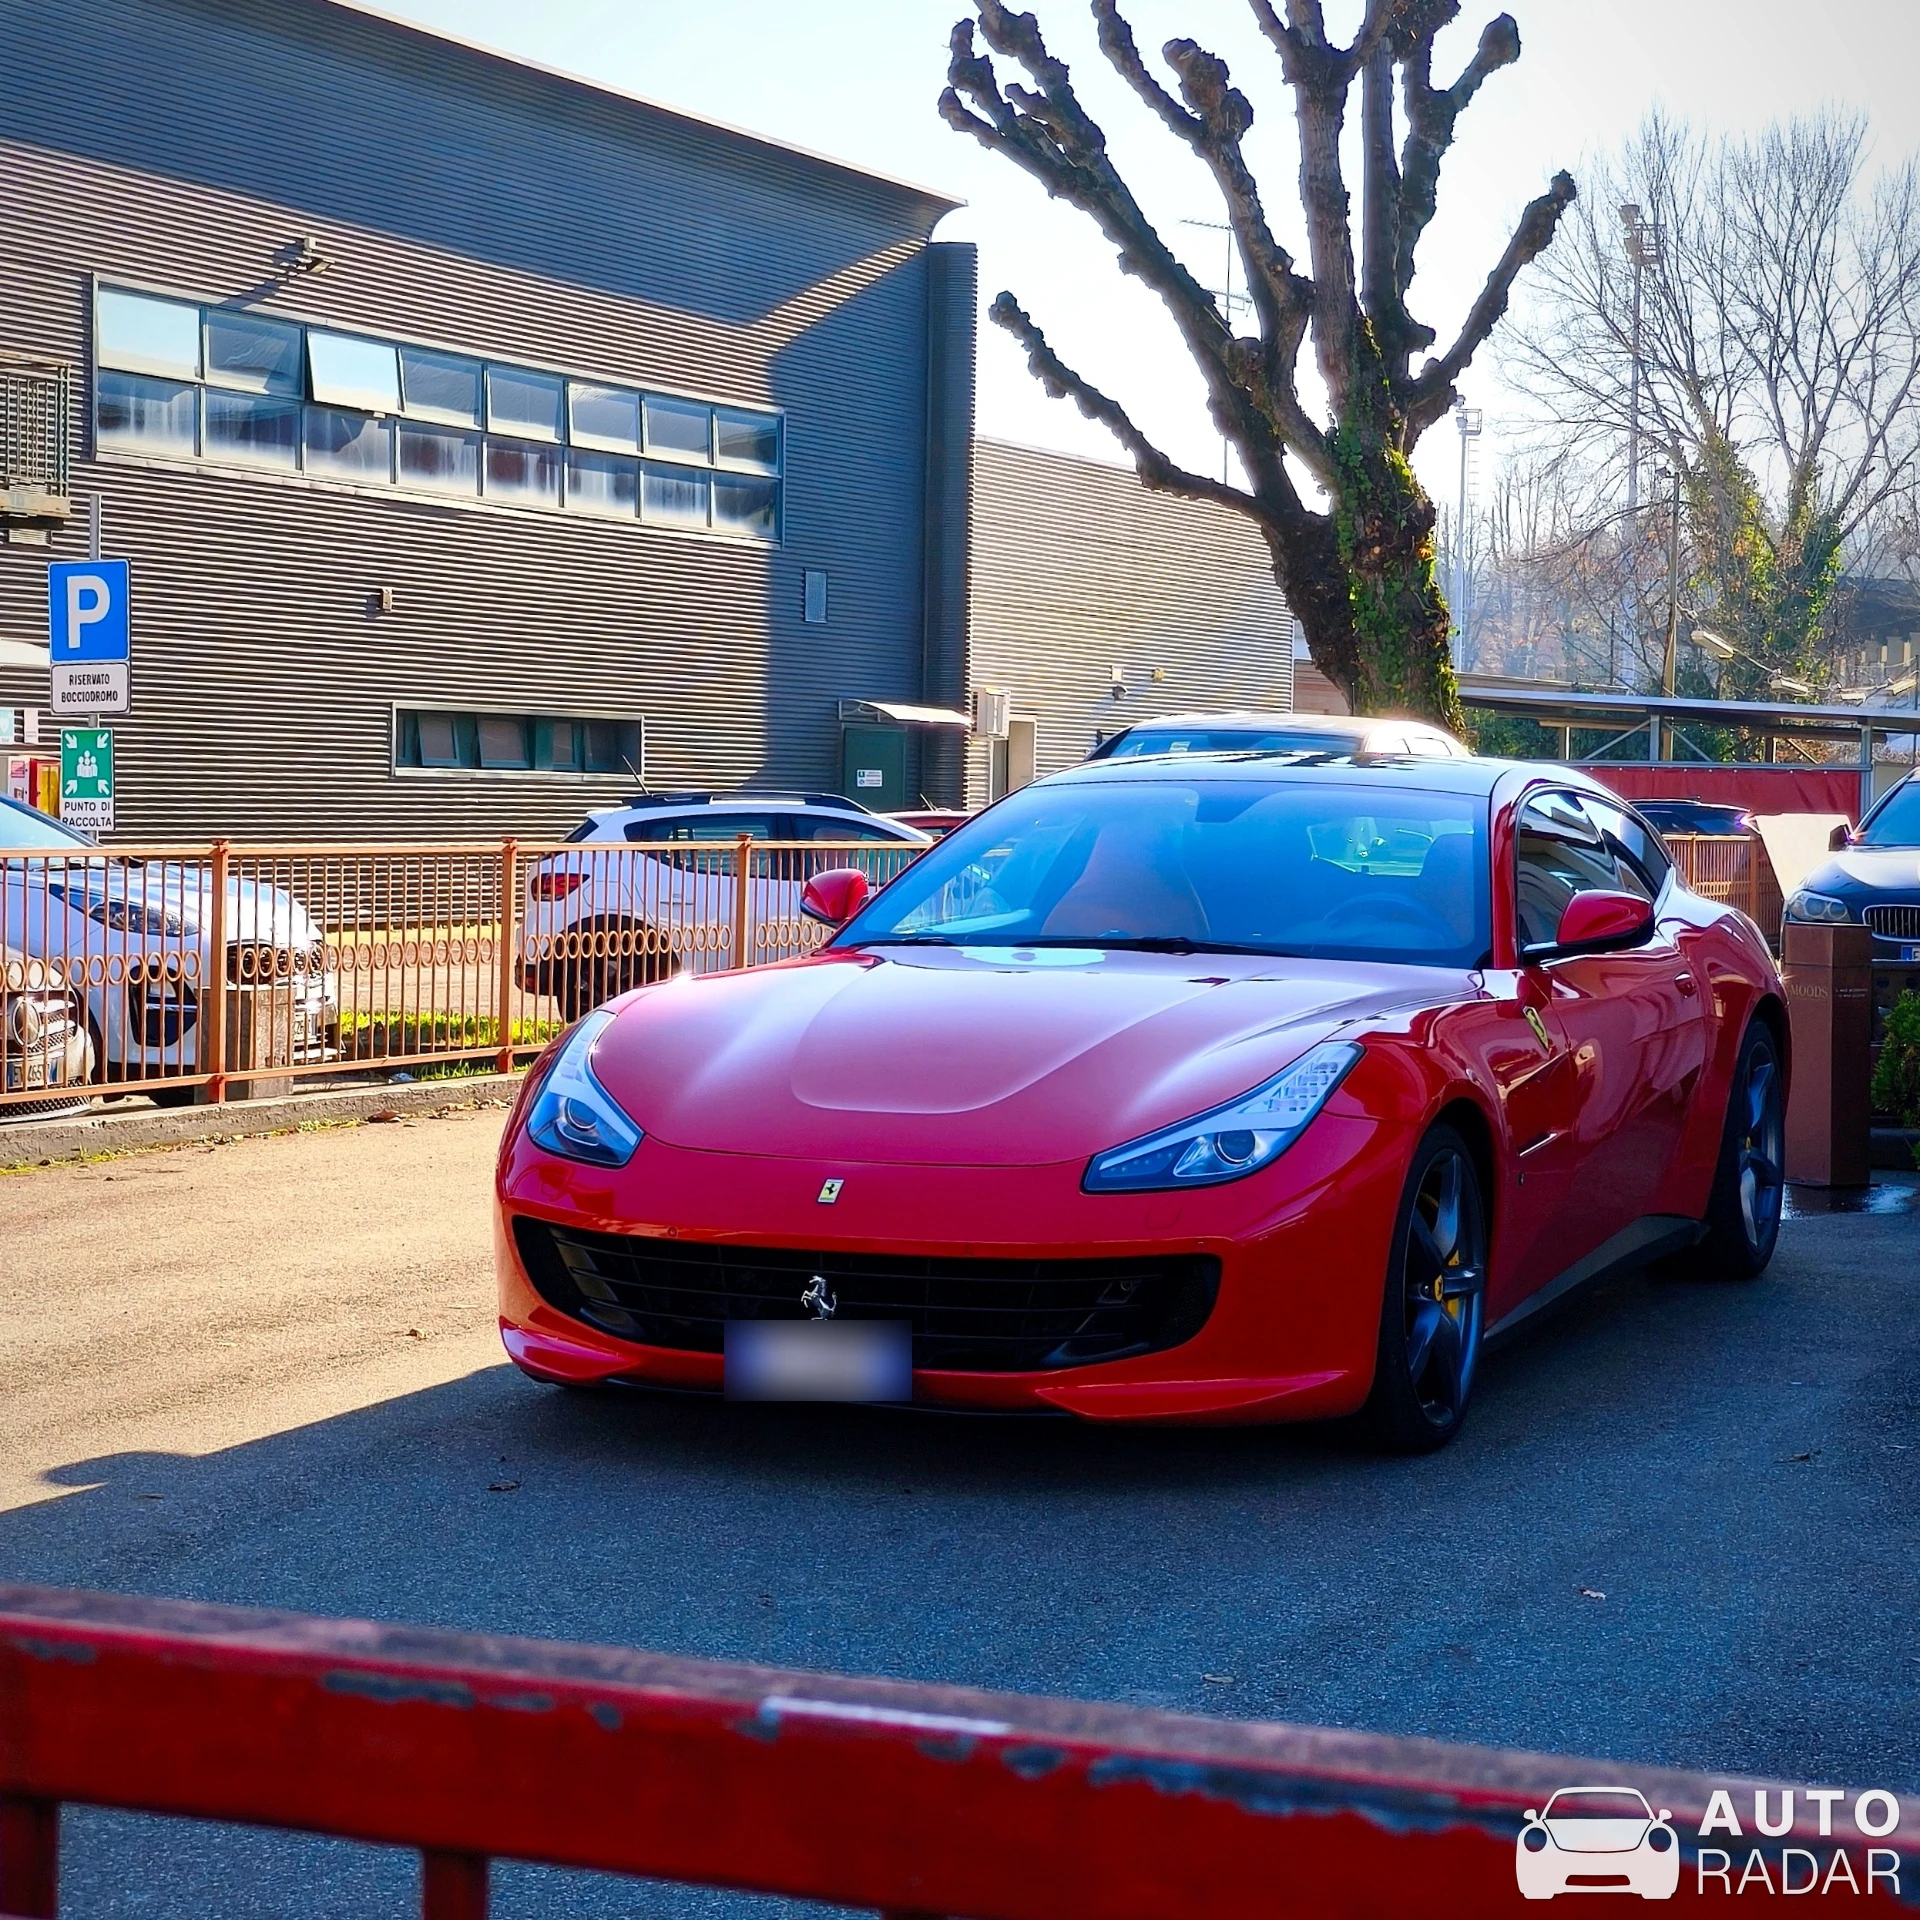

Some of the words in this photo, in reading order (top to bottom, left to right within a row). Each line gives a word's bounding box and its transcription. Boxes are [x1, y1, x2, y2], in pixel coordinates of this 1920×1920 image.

[67, 575, 110, 648] P
[69, 673, 110, 686] RISERVATO
[61, 690, 118, 703] BOCCIODROMO
[64, 801, 96, 811] PUNTO
[101, 801, 110, 811] DI
[62, 816, 112, 827] RACCOLTA
